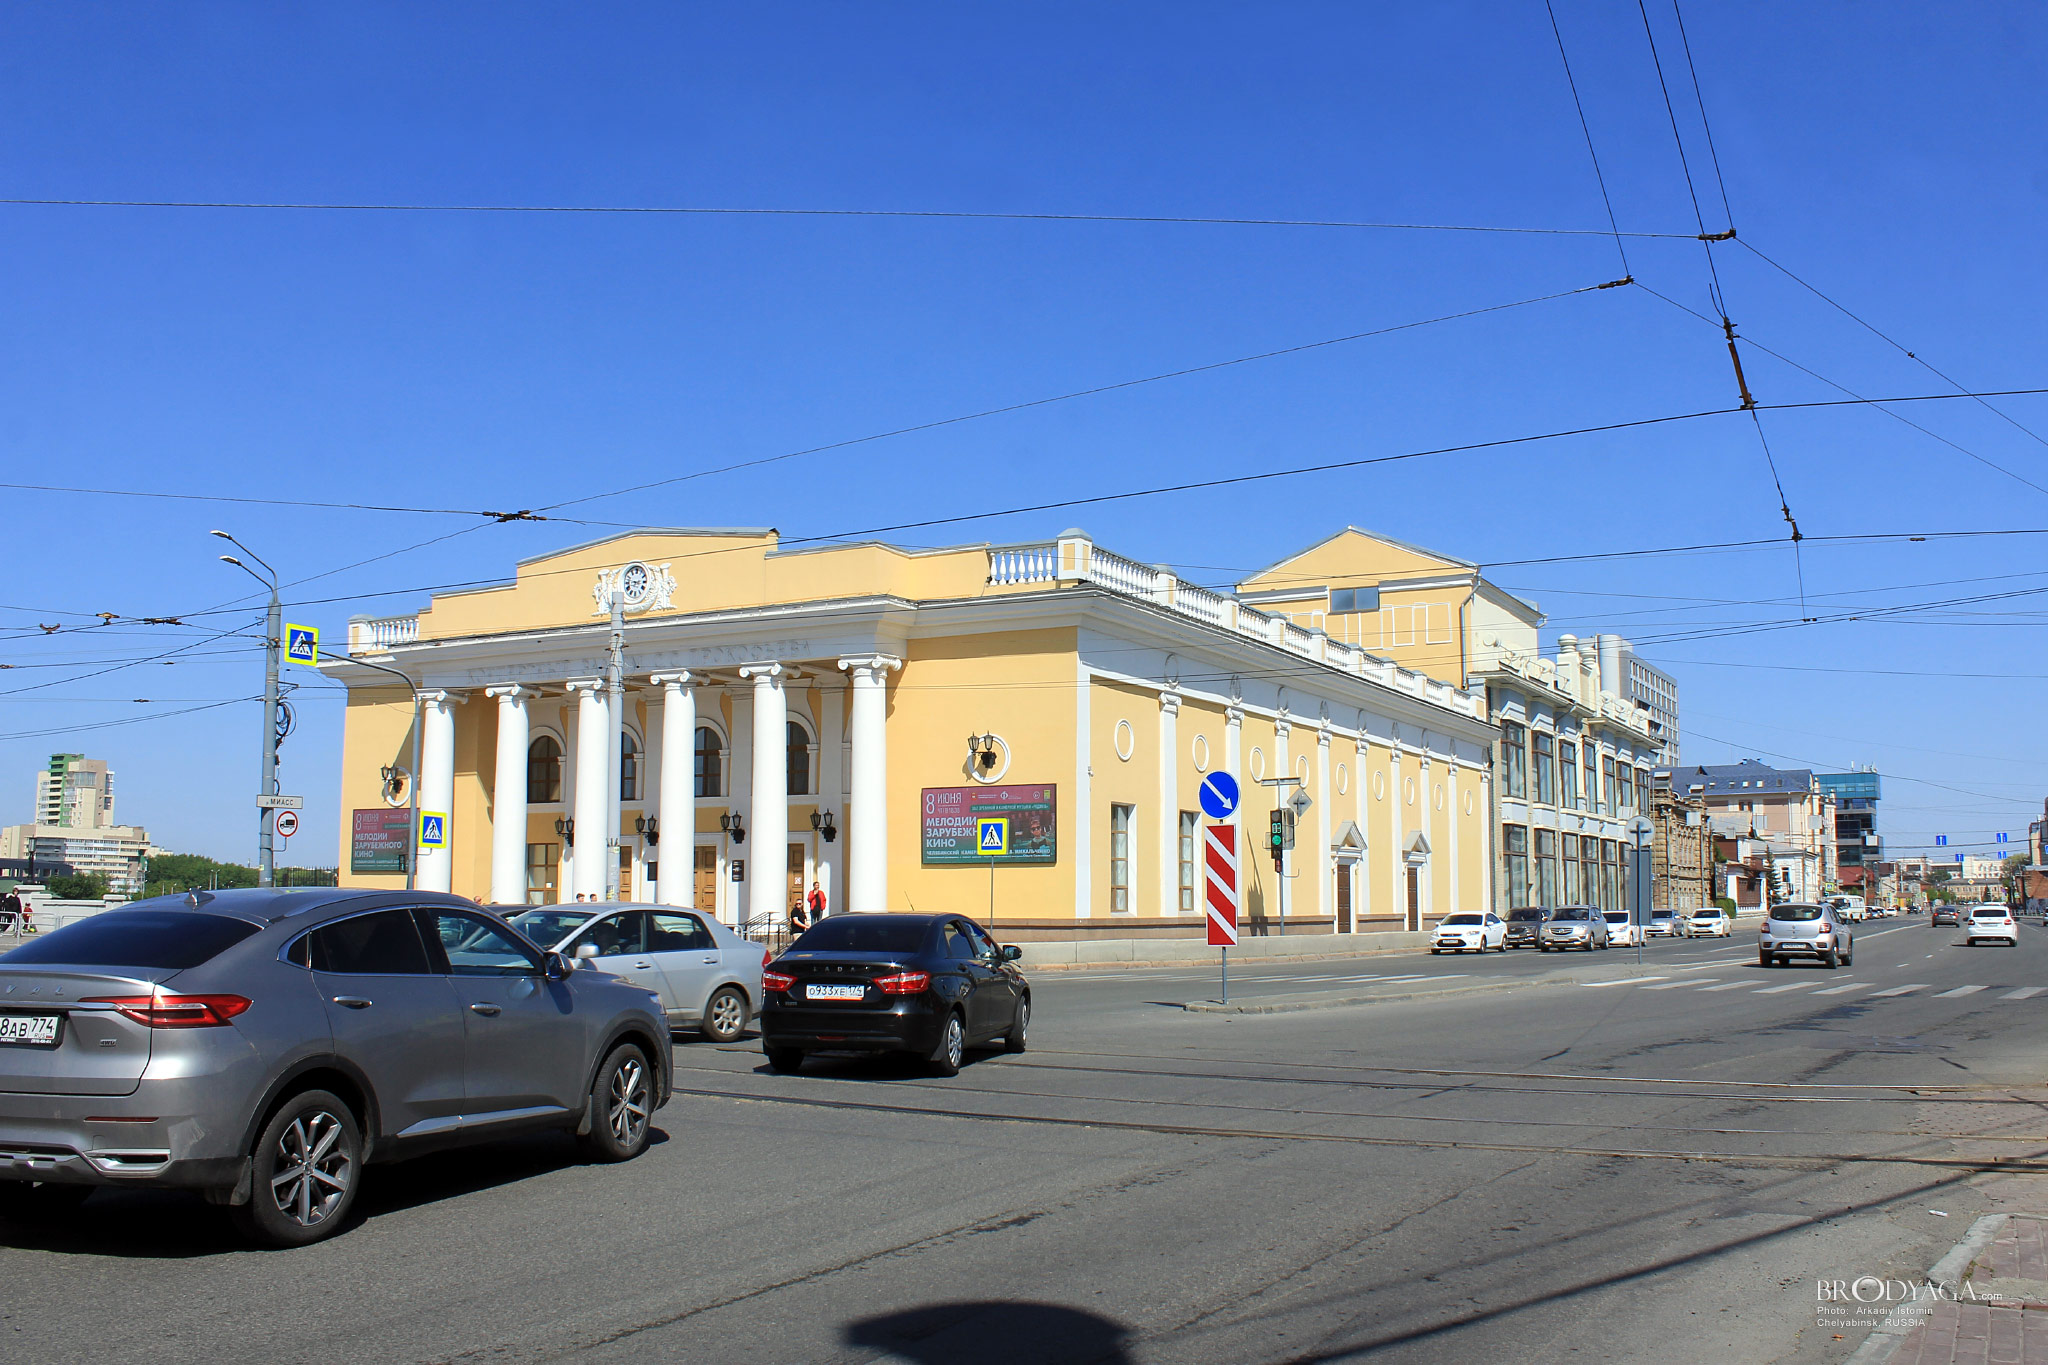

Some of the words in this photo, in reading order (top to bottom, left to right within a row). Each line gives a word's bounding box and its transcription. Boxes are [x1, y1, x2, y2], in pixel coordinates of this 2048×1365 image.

[271, 798, 293, 806] МИАСС
[926, 793, 935, 814] 8
[937, 792, 962, 804] ИЮНЯ
[355, 814, 362, 830] 8
[926, 817, 977, 827] МЕЛОДИИ
[355, 833, 388, 841] МЕЛОДИИ
[355, 841, 403, 849] ЗАРУБЕЖНОГО
[926, 838, 956, 848] КИНО
[355, 850, 374, 858] КИНО
[32, 1018, 53, 1033] 774
